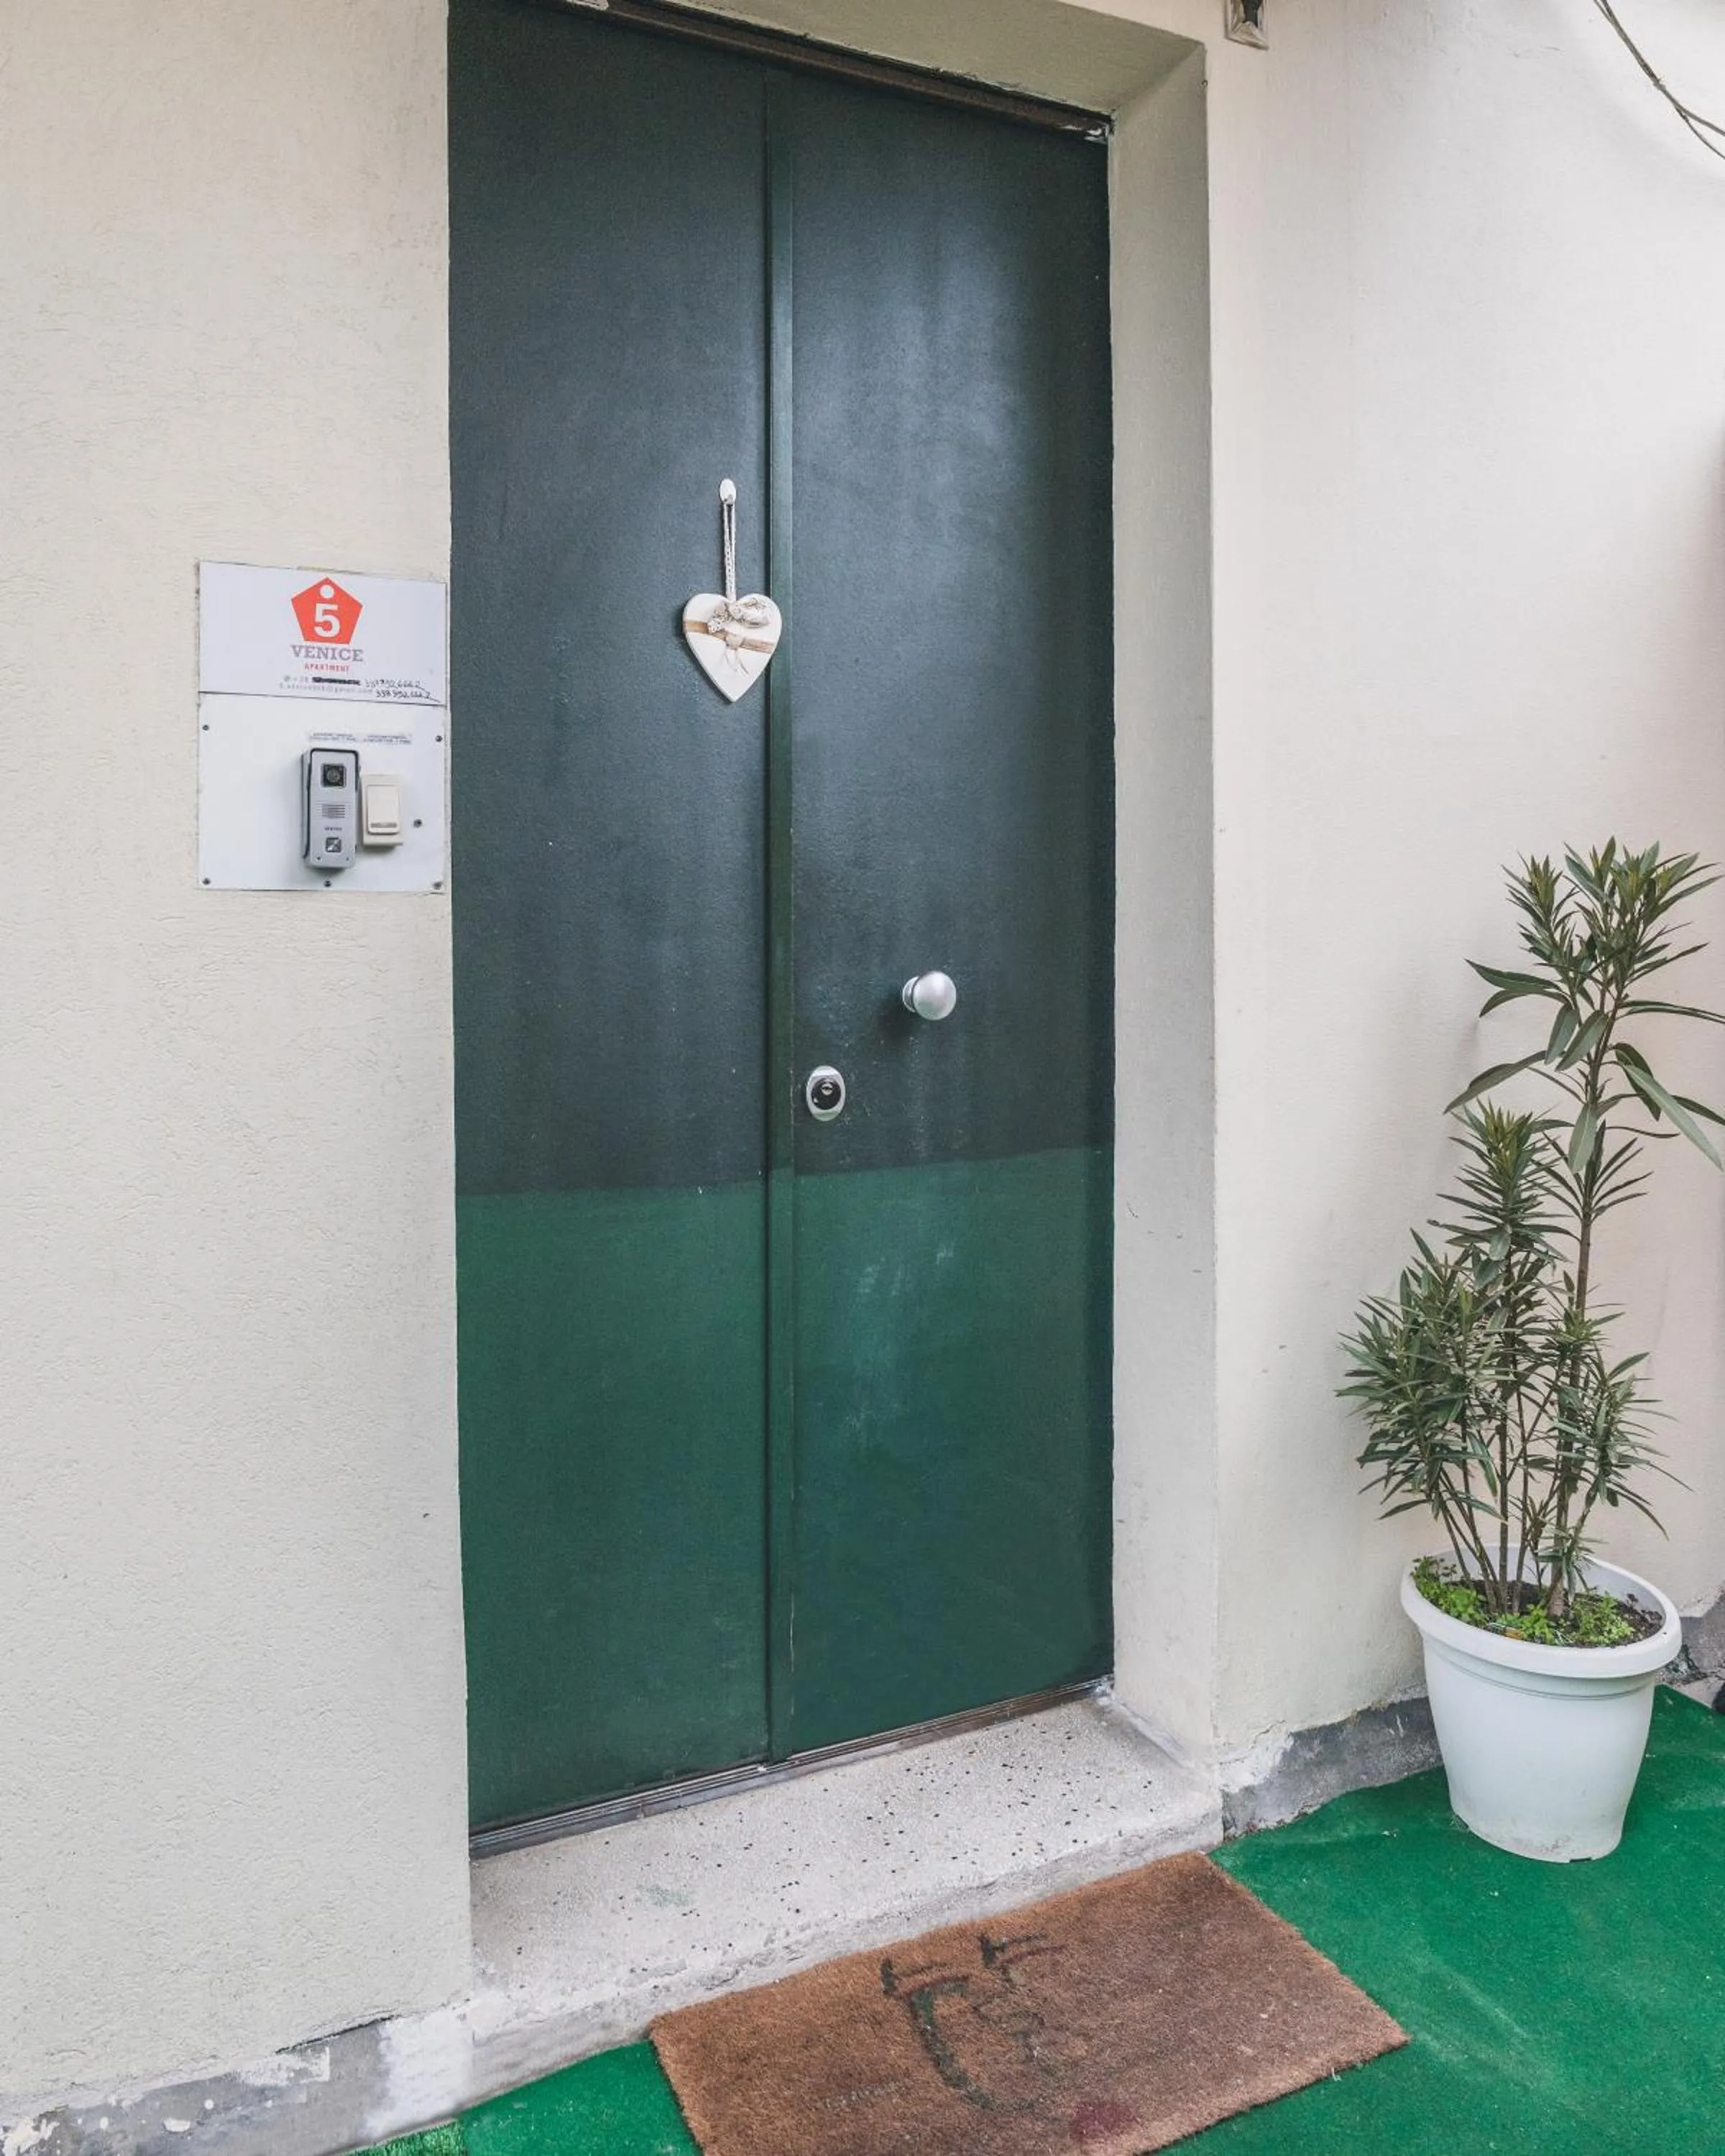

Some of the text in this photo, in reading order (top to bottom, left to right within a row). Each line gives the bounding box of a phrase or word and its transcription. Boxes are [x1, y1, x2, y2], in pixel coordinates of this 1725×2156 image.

[313, 603, 341, 637] 5
[290, 644, 364, 662] VENICE
[304, 663, 351, 673] APARTMENT
